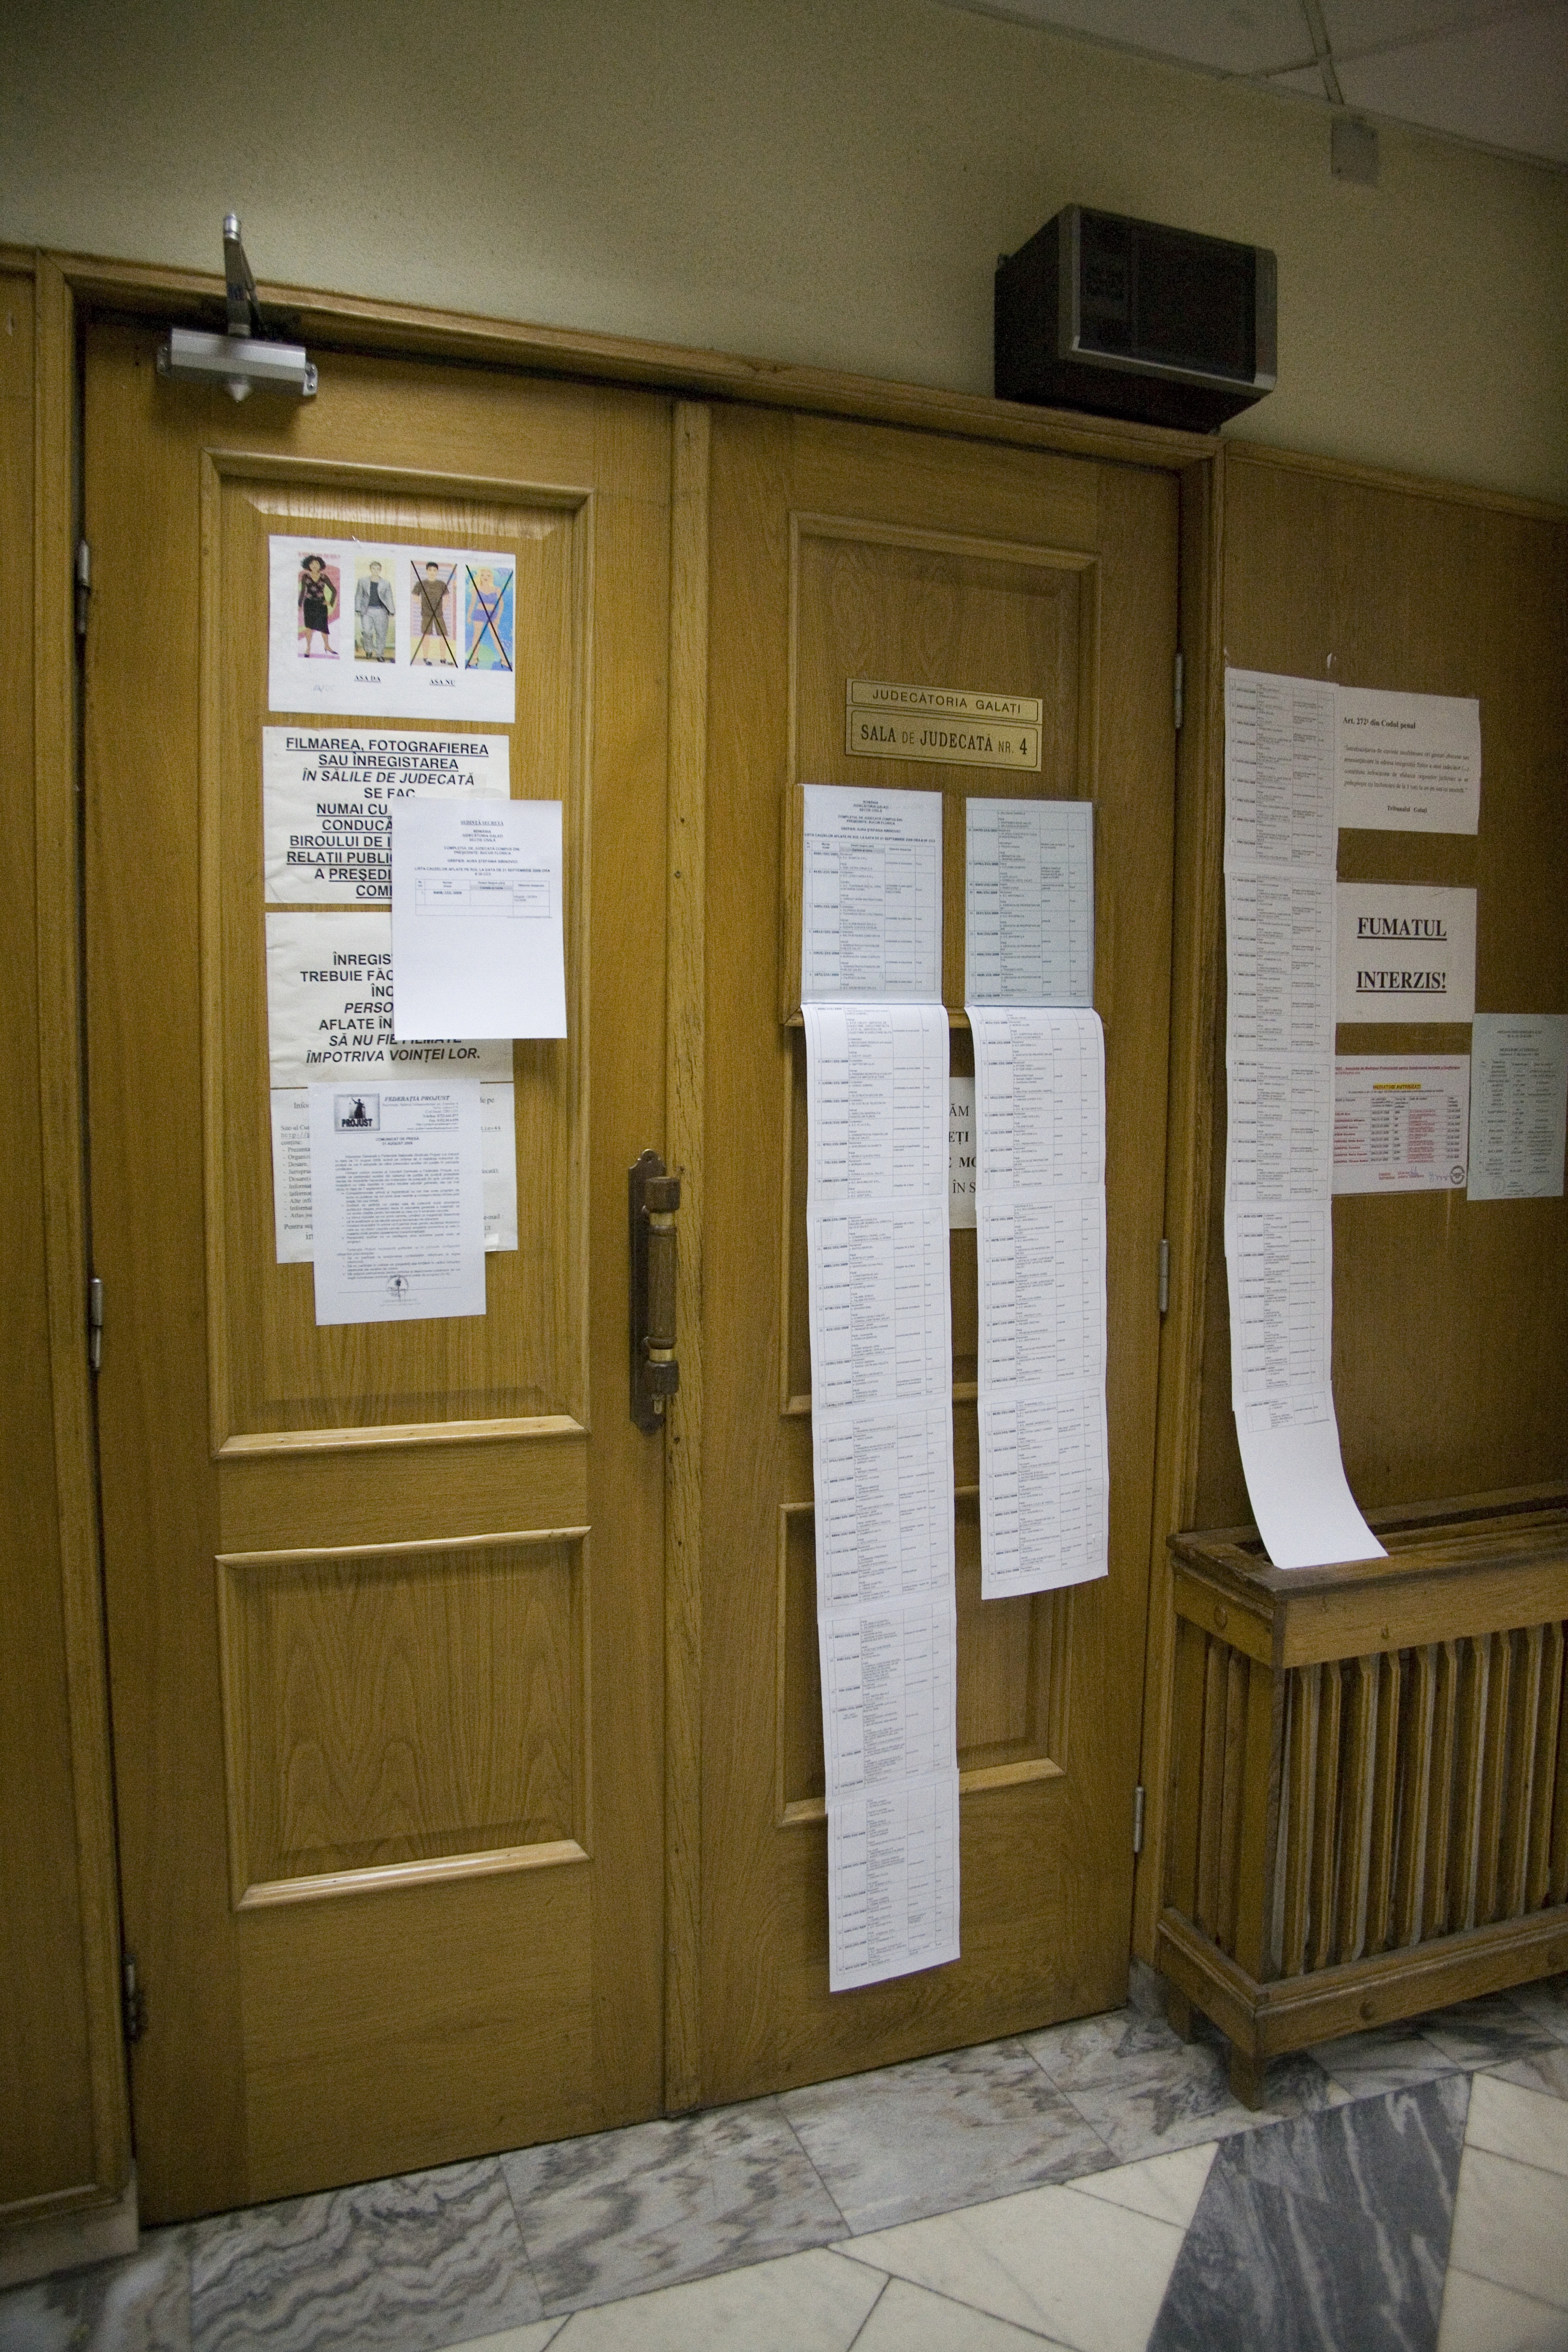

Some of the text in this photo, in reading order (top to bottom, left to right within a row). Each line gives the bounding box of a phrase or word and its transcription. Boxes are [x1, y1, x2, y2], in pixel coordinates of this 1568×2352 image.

[286, 737, 489, 755] FILMAREA, FOTOGRAFIEREA
[861, 724, 1027, 755] SALA DE JUDECATĂ NR. 4
[319, 752, 459, 769] SAU ÎNREGISTAREA
[302, 767, 475, 786] ÎN SĂLILE DE JUDECATĂ
[364, 787, 416, 799] SE FAC
[317, 803, 388, 815] NUMAI CU
[290, 835, 359, 847] BIROULUI
[363, 836, 382, 847] DE
[347, 852, 392, 864] PUBLI
[314, 868, 325, 879] A
[1357, 917, 1447, 937] FUMATUL
[333, 951, 393, 966] ÎNREGIS
[300, 970, 362, 983] TREBUIE
[1356, 971, 1446, 990] INTERZIS!
[319, 1015, 393, 1031] AFLATE ÎN
[329, 1032, 348, 1046] SĂ
[352, 1034, 373, 1046] NU
[377, 1034, 398, 1045] FIE
[306, 1049, 384, 1064] ÎMPOTRIVA
[448, 1047, 480, 1059] LOR.
[341, 1118, 373, 1128] PROJUST
[953, 1179, 966, 1193] ÎN
